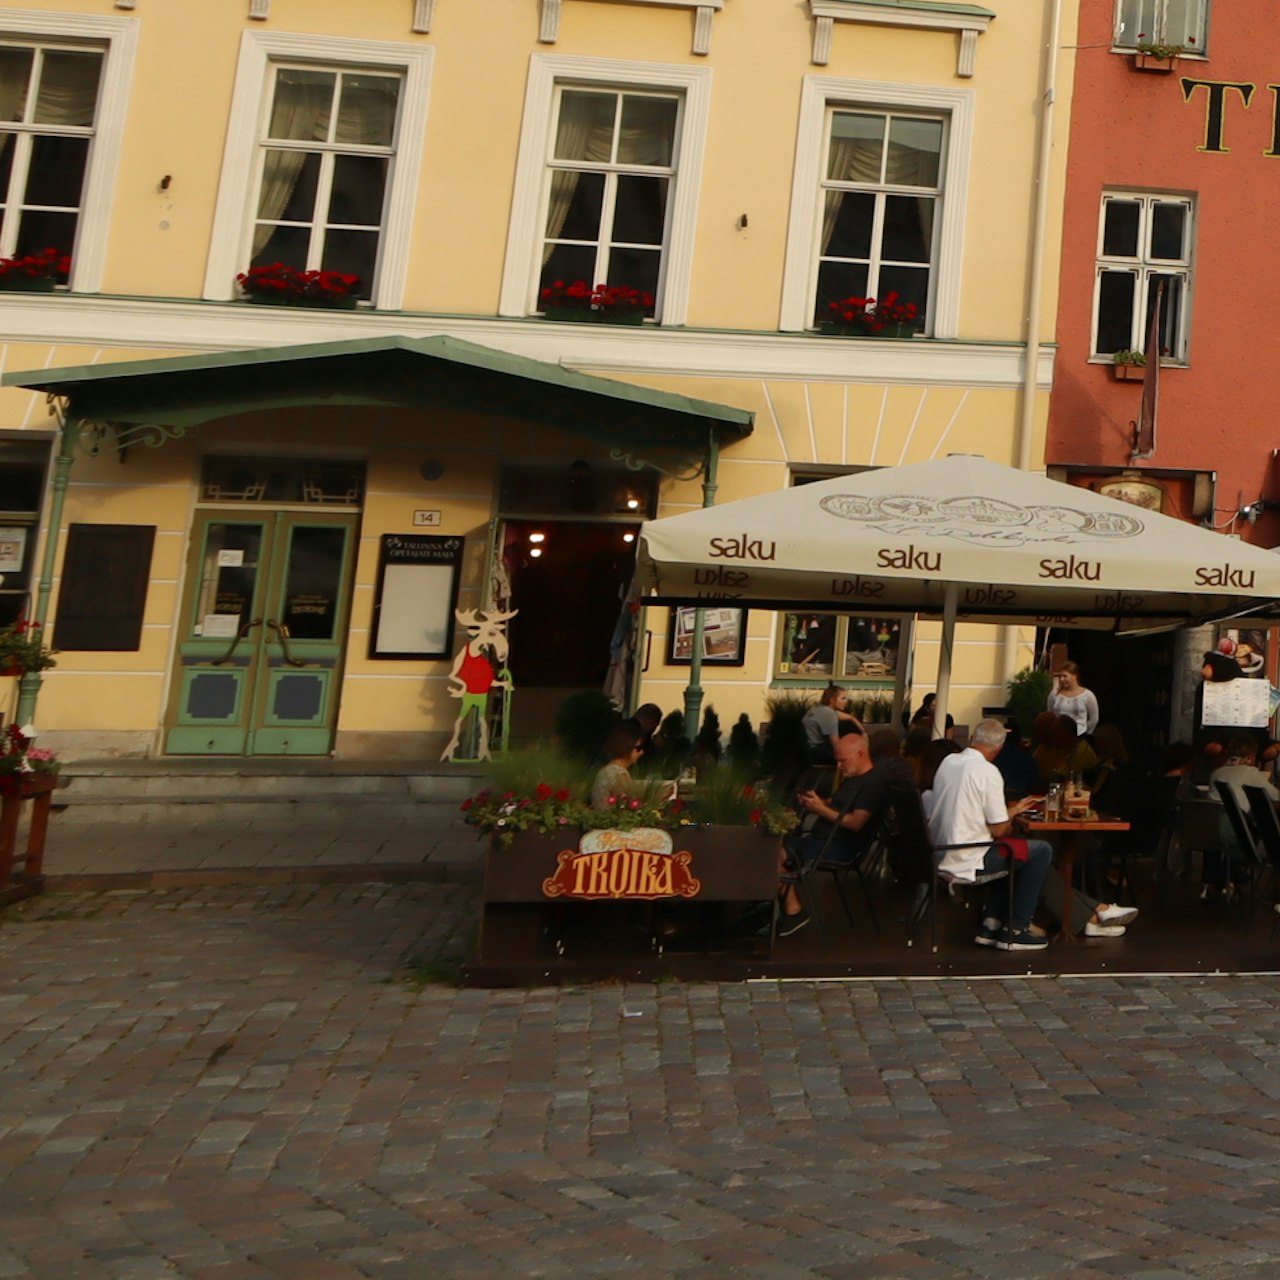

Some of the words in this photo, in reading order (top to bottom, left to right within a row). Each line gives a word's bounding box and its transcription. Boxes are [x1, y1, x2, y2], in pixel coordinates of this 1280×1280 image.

[420, 513, 433, 523] 14
[708, 533, 776, 561] saku
[876, 544, 942, 571] saku
[1038, 554, 1101, 581] saku
[1195, 563, 1255, 589] saku
[571, 850, 674, 897] TROIKA
